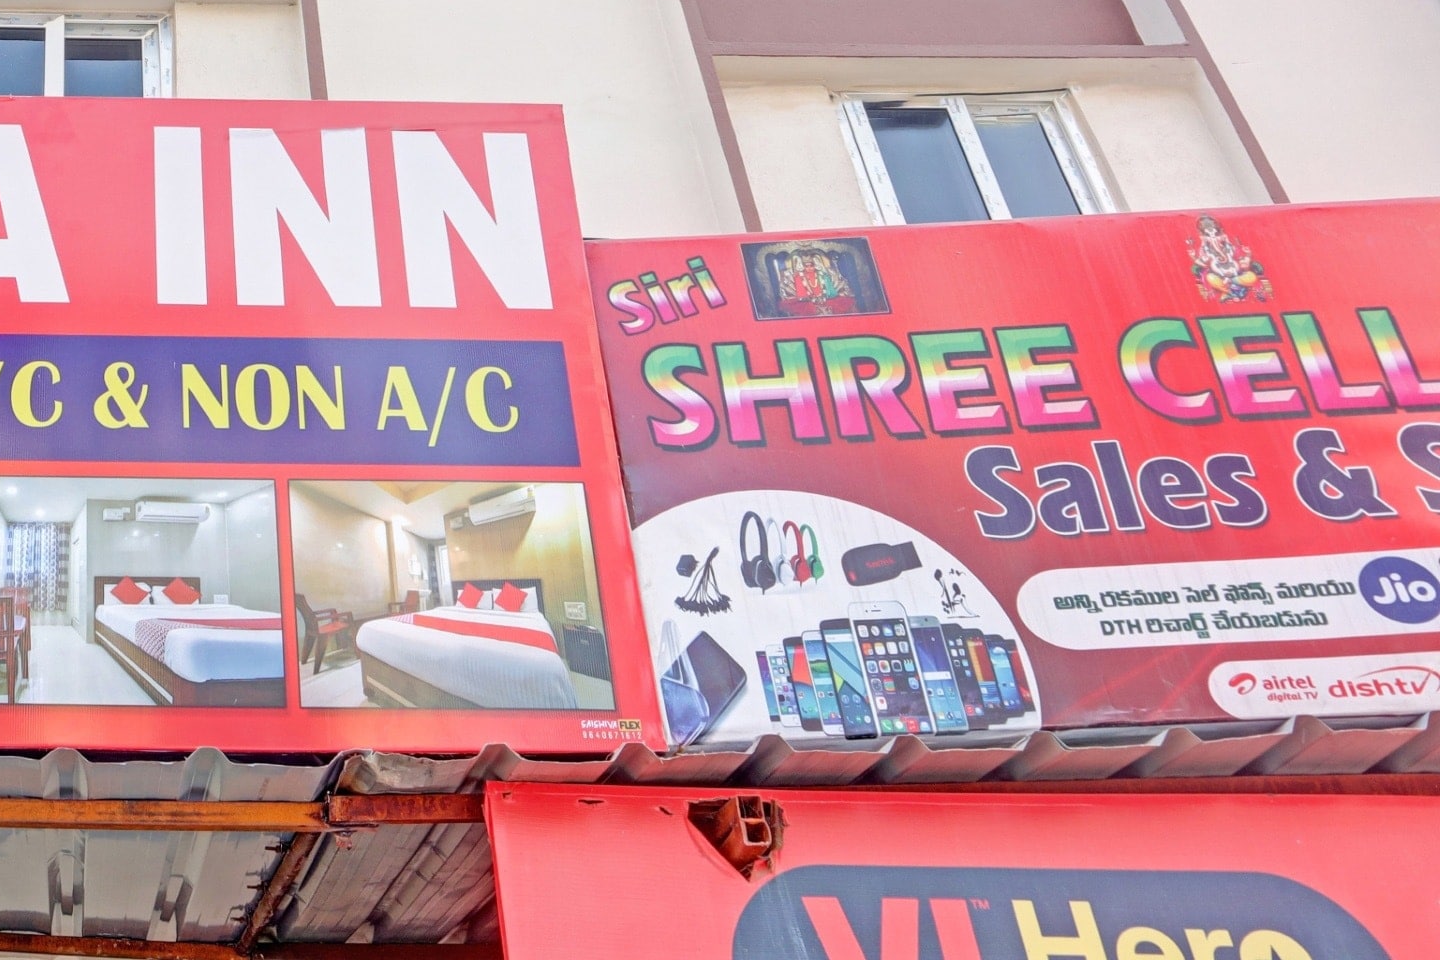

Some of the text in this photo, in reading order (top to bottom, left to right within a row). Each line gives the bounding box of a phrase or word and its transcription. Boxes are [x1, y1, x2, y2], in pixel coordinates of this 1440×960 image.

[153, 126, 554, 310] INN
[607, 256, 727, 336] Siri
[94, 363, 150, 428] &
[181, 364, 346, 431] NON
[376, 366, 521, 448] A/C
[642, 306, 1440, 452] SHREE CELL
[963, 439, 1269, 538] Sales
[1292, 426, 1398, 520] &
[1373, 571, 1437, 606] Jio
[1100, 619, 1143, 636] DTH
[1262, 672, 1432, 699] airtel dishtv
[1267, 692, 1318, 703] digital TV
[619, 720, 641, 730] FLEX
